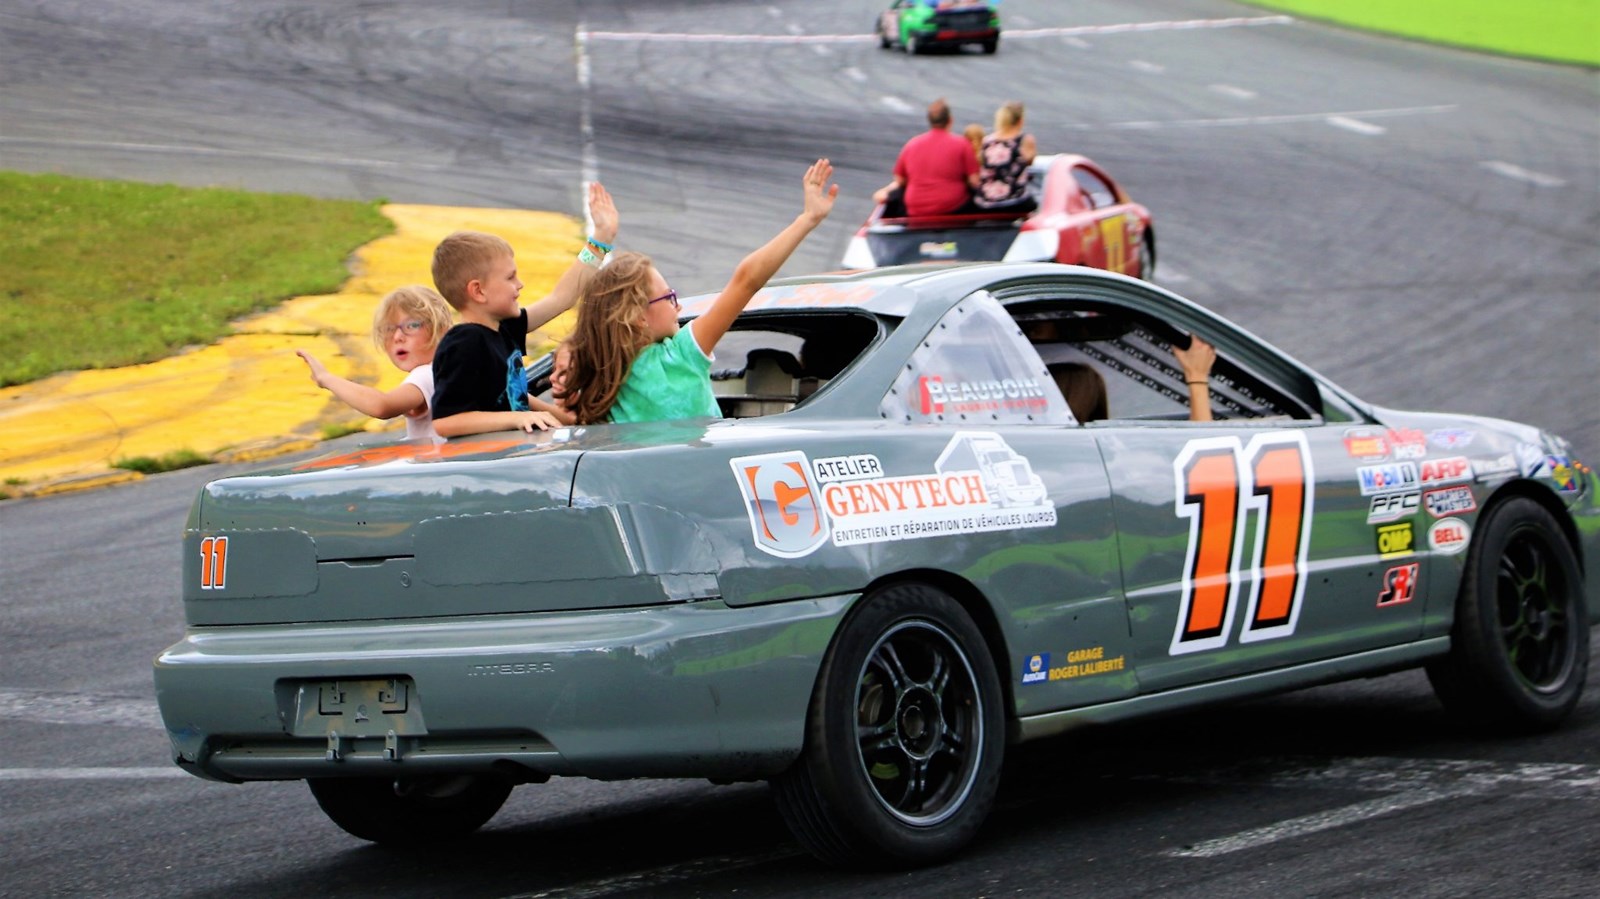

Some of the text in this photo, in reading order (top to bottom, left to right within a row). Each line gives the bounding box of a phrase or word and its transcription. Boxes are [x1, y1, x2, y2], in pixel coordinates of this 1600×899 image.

[925, 378, 1044, 404] BEAUDOIN
[817, 458, 881, 479] ATELIER
[1361, 467, 1399, 488] Mobil
[1421, 459, 1467, 481] ARP
[825, 475, 987, 517] GENYTECH
[1371, 492, 1420, 513] PFC
[836, 511, 1055, 542] ENTRETIEN ET RÉPARATION DE VÉHICULES LOURDS
[1169, 430, 1315, 656] 11
[1378, 529, 1412, 552] OMP
[1434, 532, 1464, 544] BELL
[200, 536, 228, 589] 11
[1067, 647, 1104, 663] GARAGE
[467, 662, 556, 676] INTEGRA
[1049, 665, 1079, 680] ROGER
[1080, 655, 1125, 675] LALIBERTÉ
